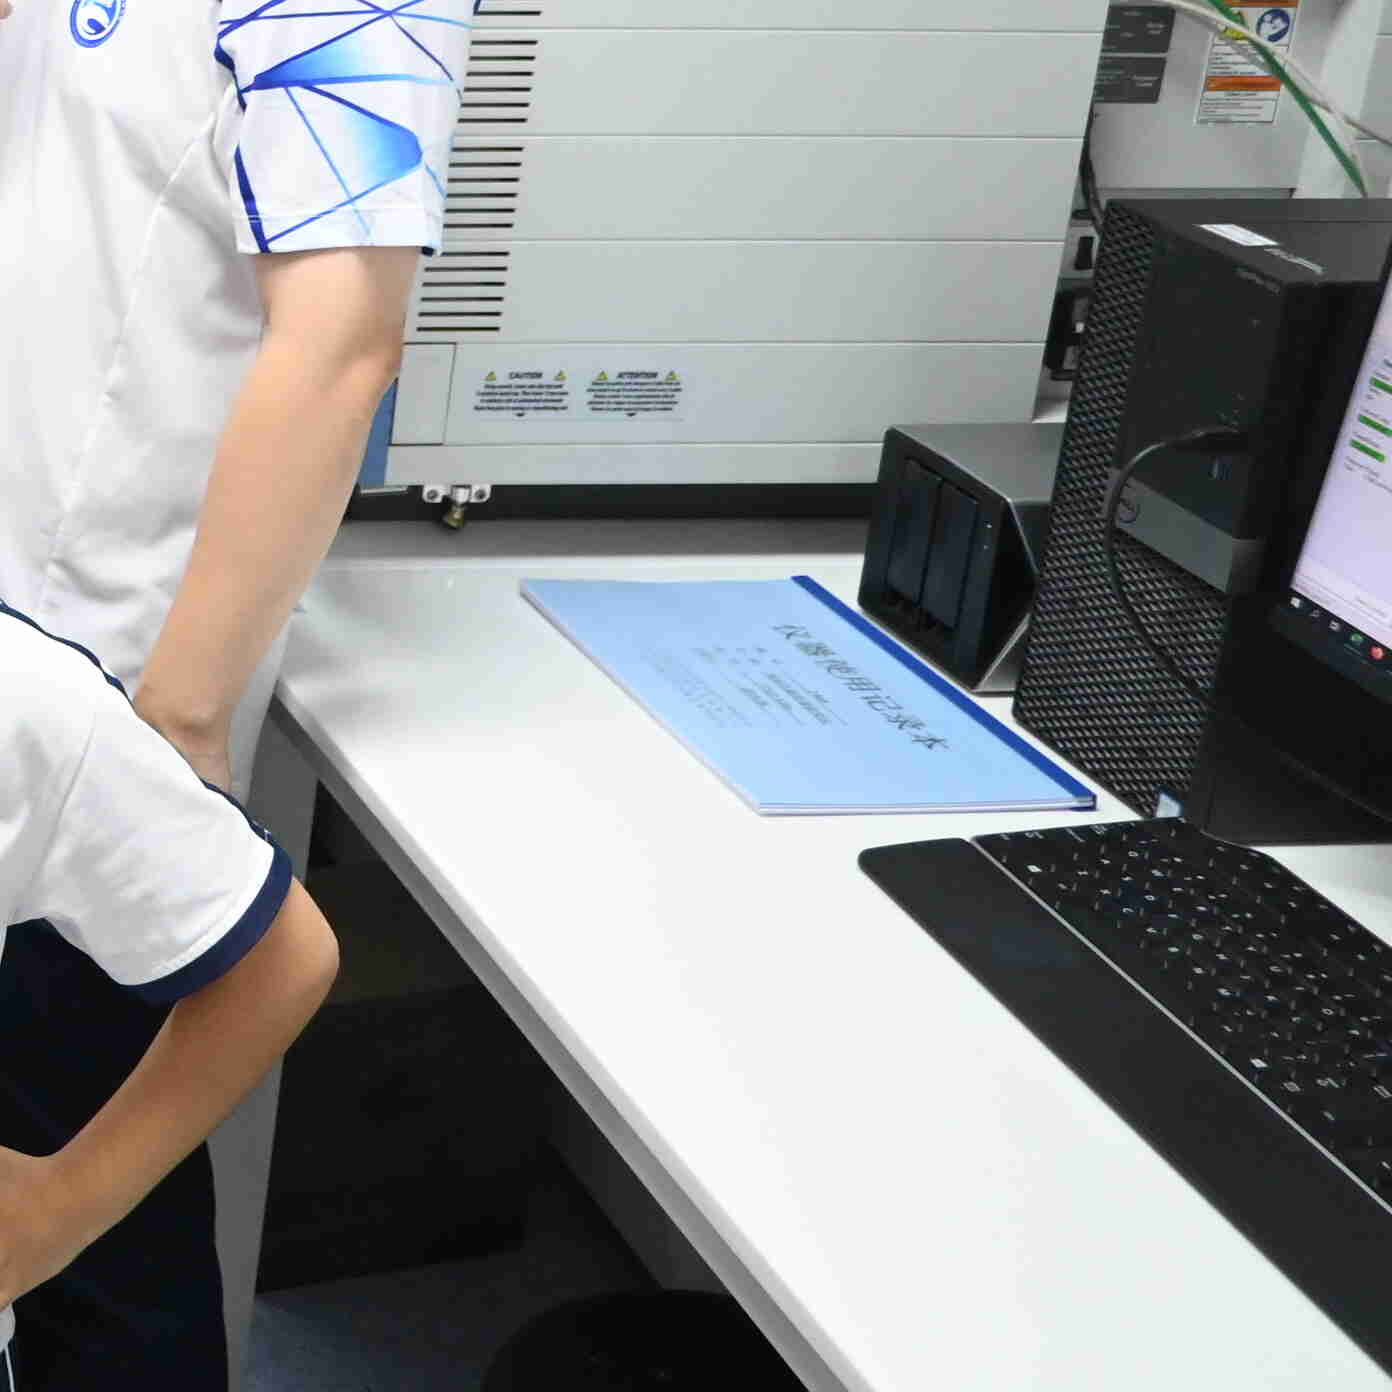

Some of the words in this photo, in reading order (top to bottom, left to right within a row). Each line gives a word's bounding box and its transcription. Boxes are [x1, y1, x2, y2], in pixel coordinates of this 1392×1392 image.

[771, 624, 951, 750] 仪器使用记录本
